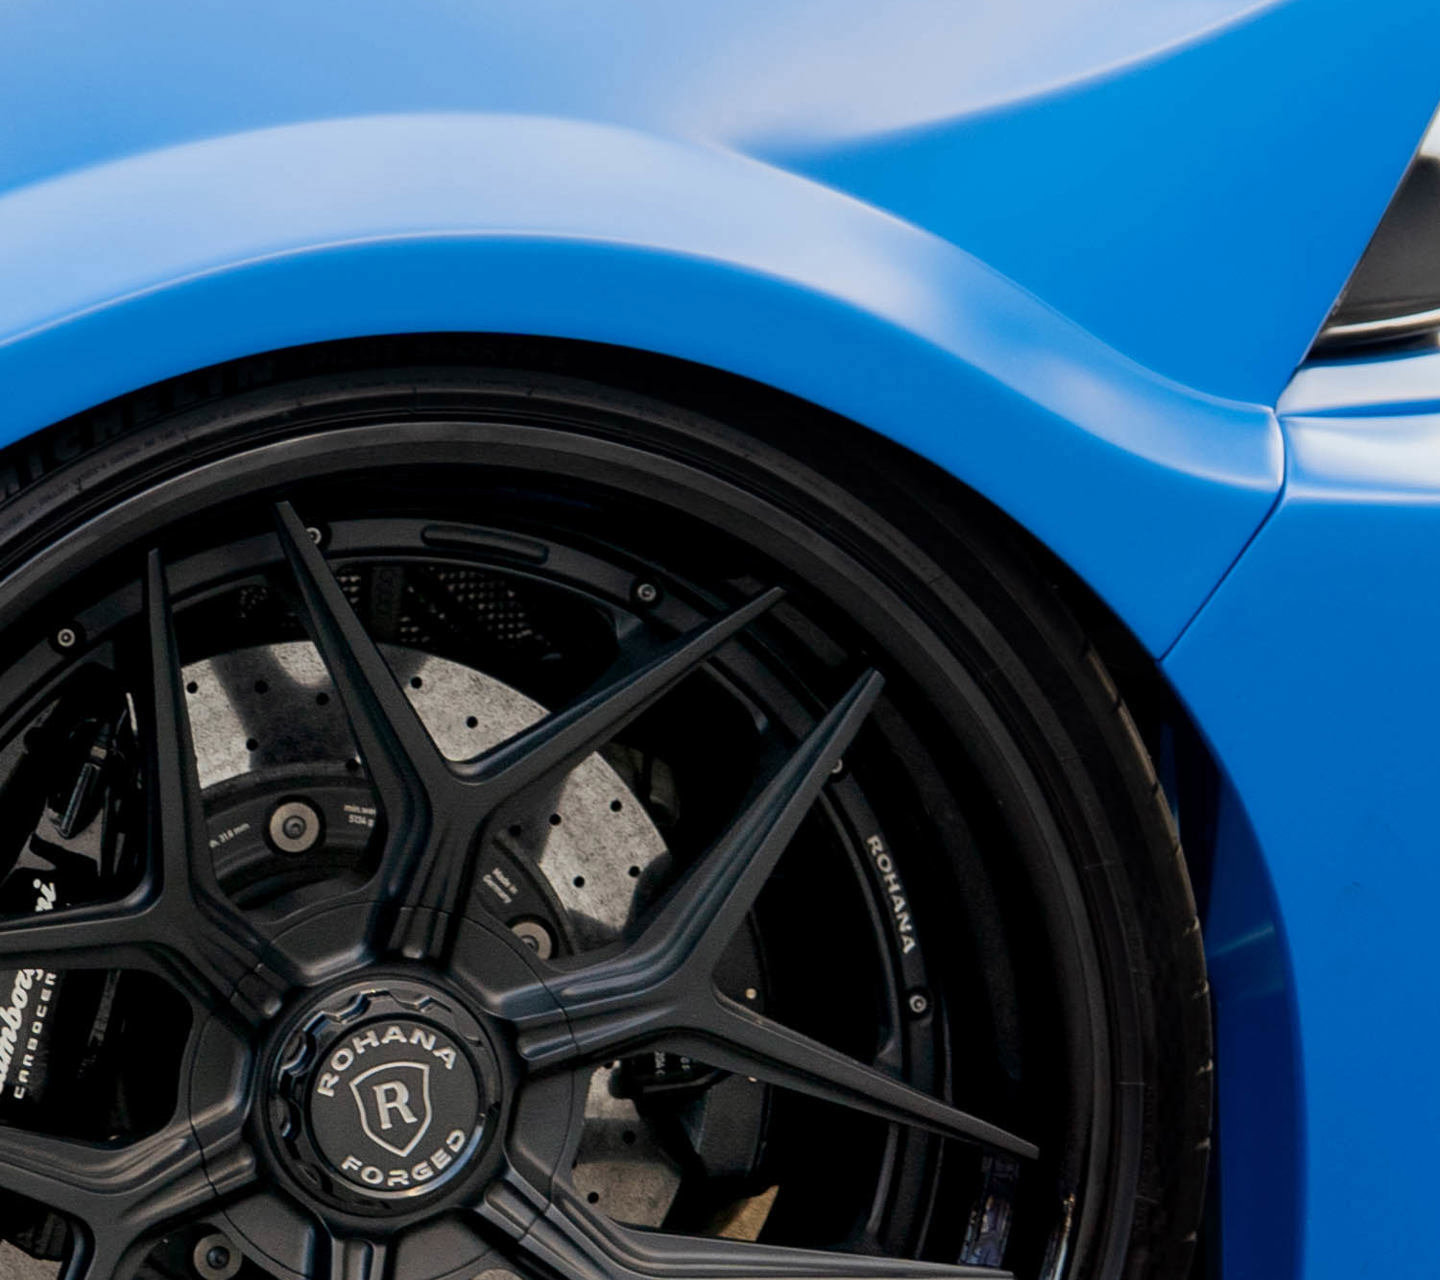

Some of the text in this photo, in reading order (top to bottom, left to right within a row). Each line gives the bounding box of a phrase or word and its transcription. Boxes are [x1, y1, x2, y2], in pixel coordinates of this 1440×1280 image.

[867, 834, 917, 955] ROHANA
[317, 1024, 458, 1098] ROHANA
[372, 1080, 418, 1131] R
[341, 1128, 466, 1187] FORGED
